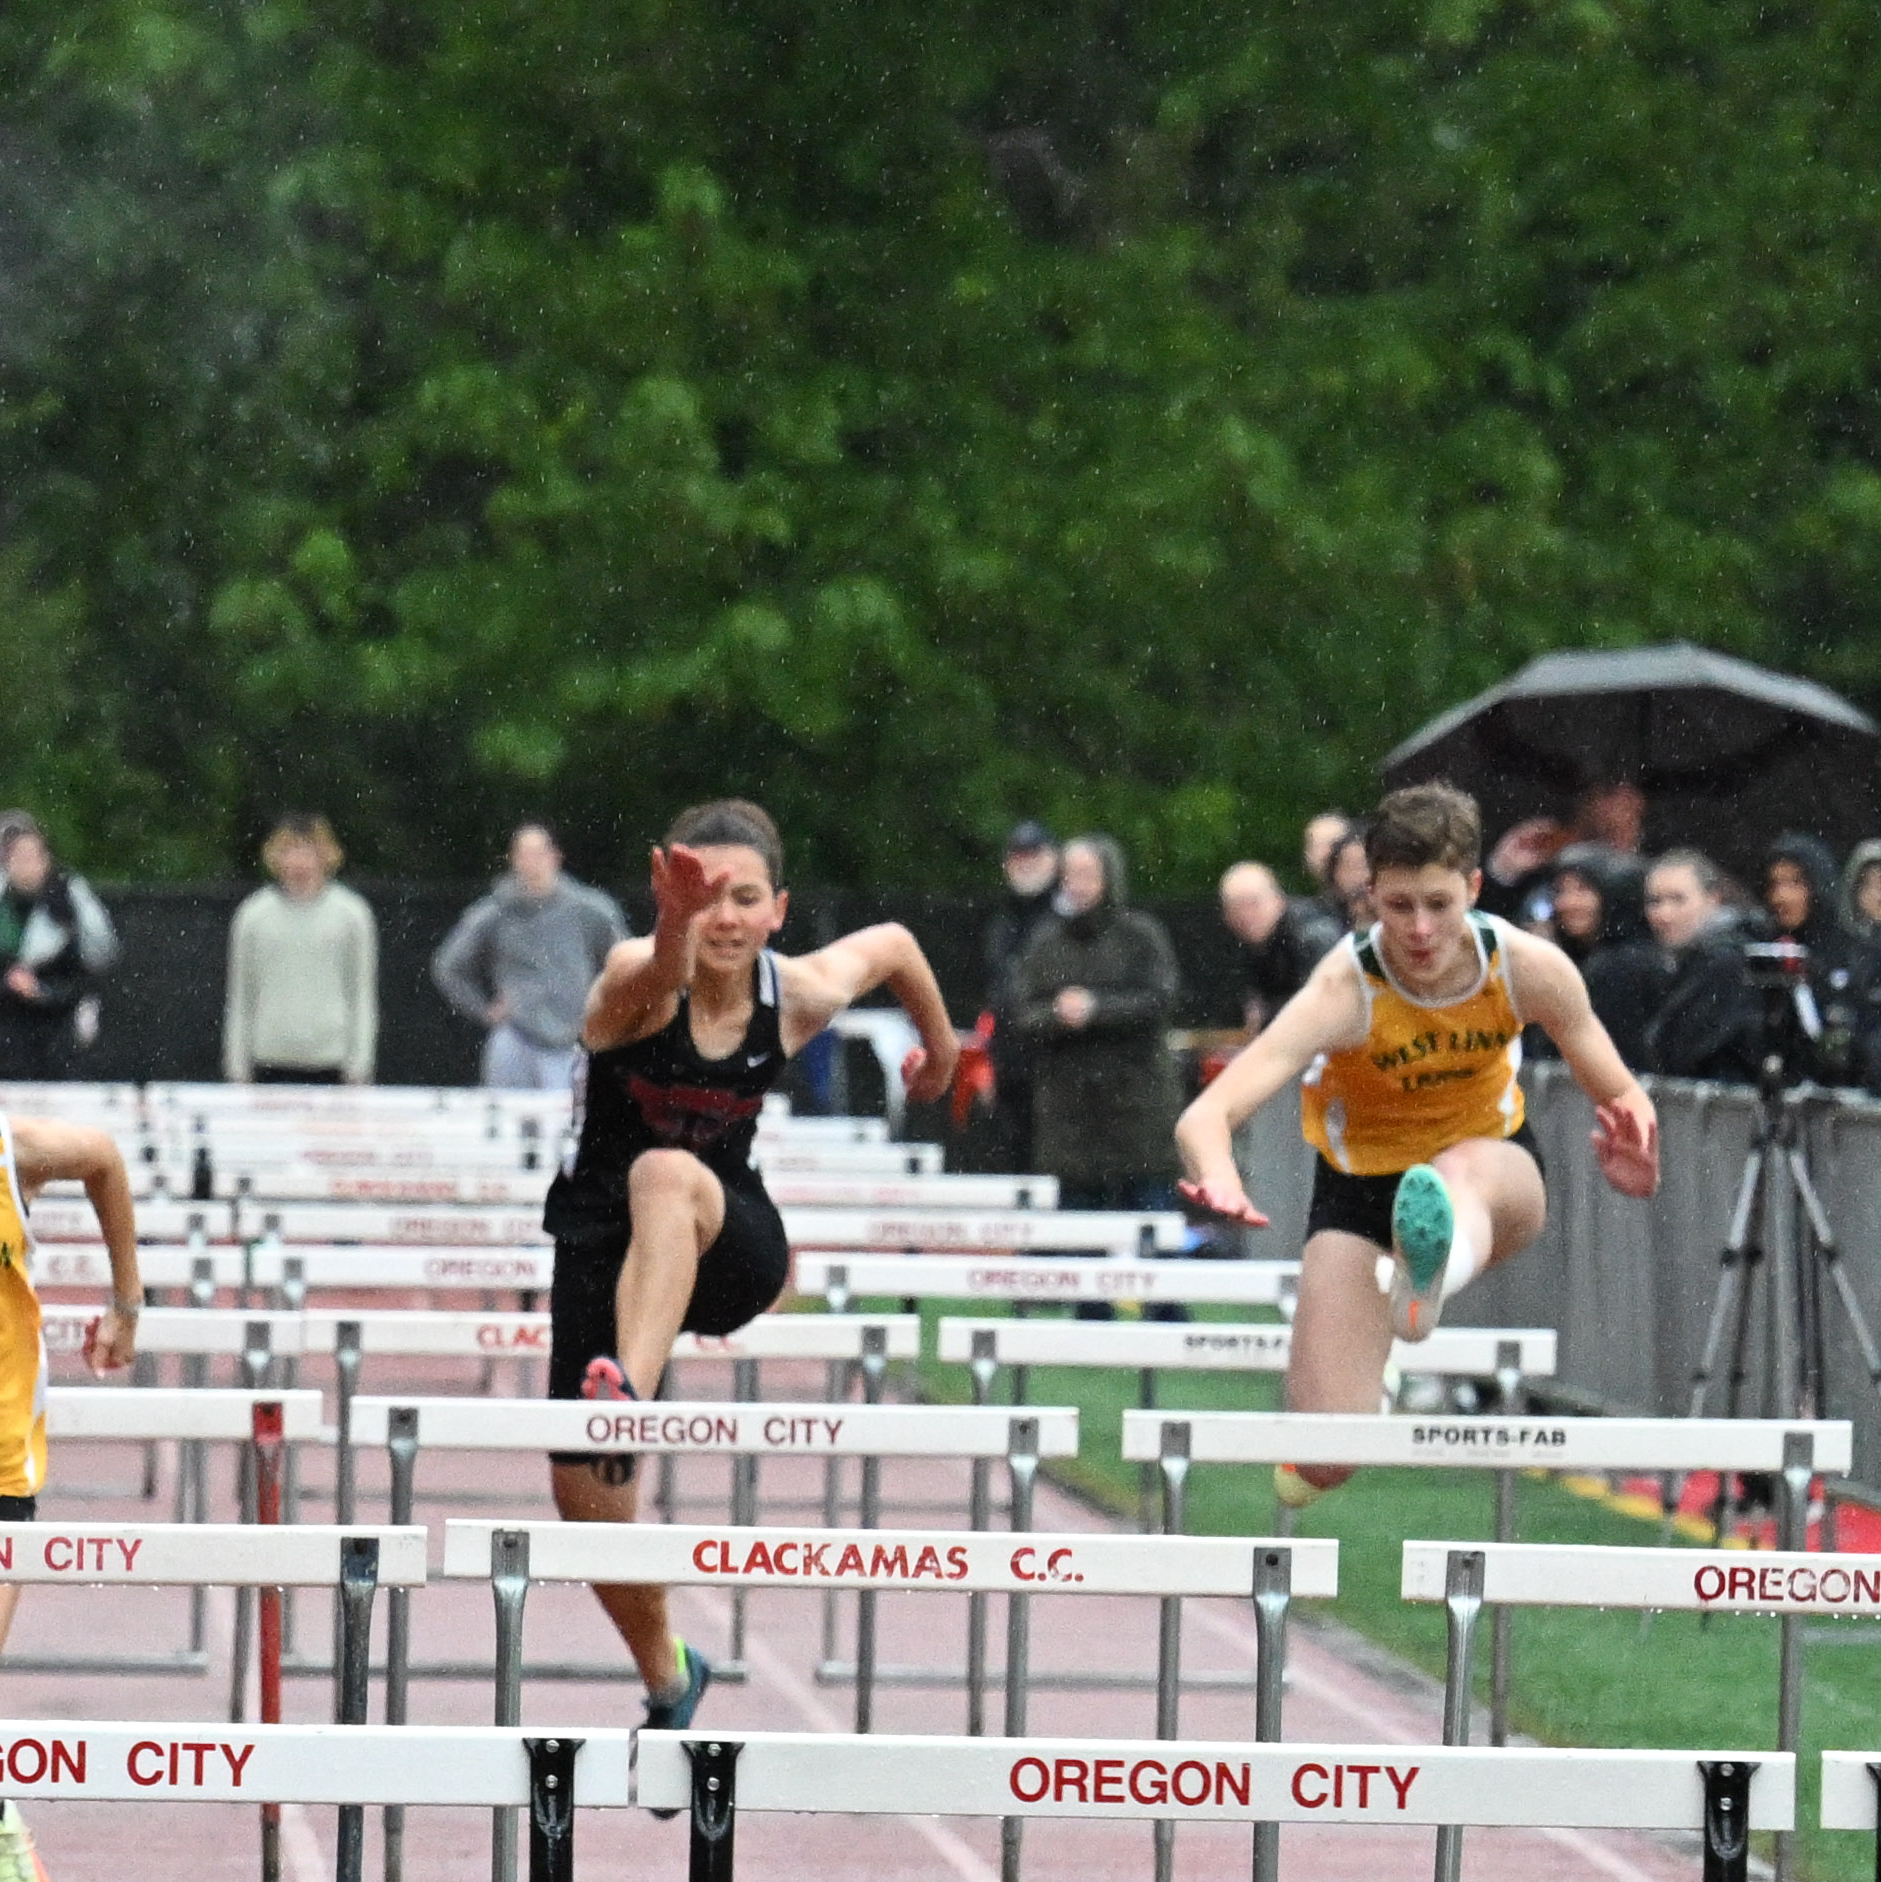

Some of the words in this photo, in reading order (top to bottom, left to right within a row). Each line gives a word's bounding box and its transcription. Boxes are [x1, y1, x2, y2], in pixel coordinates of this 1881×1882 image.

[585, 1415, 738, 1445] OREGON
[763, 1416, 844, 1446] CITY
[1411, 1426, 1567, 1446] SPORTS-FAB
[43, 1536, 143, 1572] CITY
[692, 1539, 969, 1580] CLACKAMAS
[1009, 1546, 1085, 1582] C.C.
[1693, 1565, 1881, 1604] OREGON
[126, 1740, 255, 1787] CITY
[1009, 1756, 1251, 1807] OREGON
[1291, 1762, 1420, 1810] CITY
